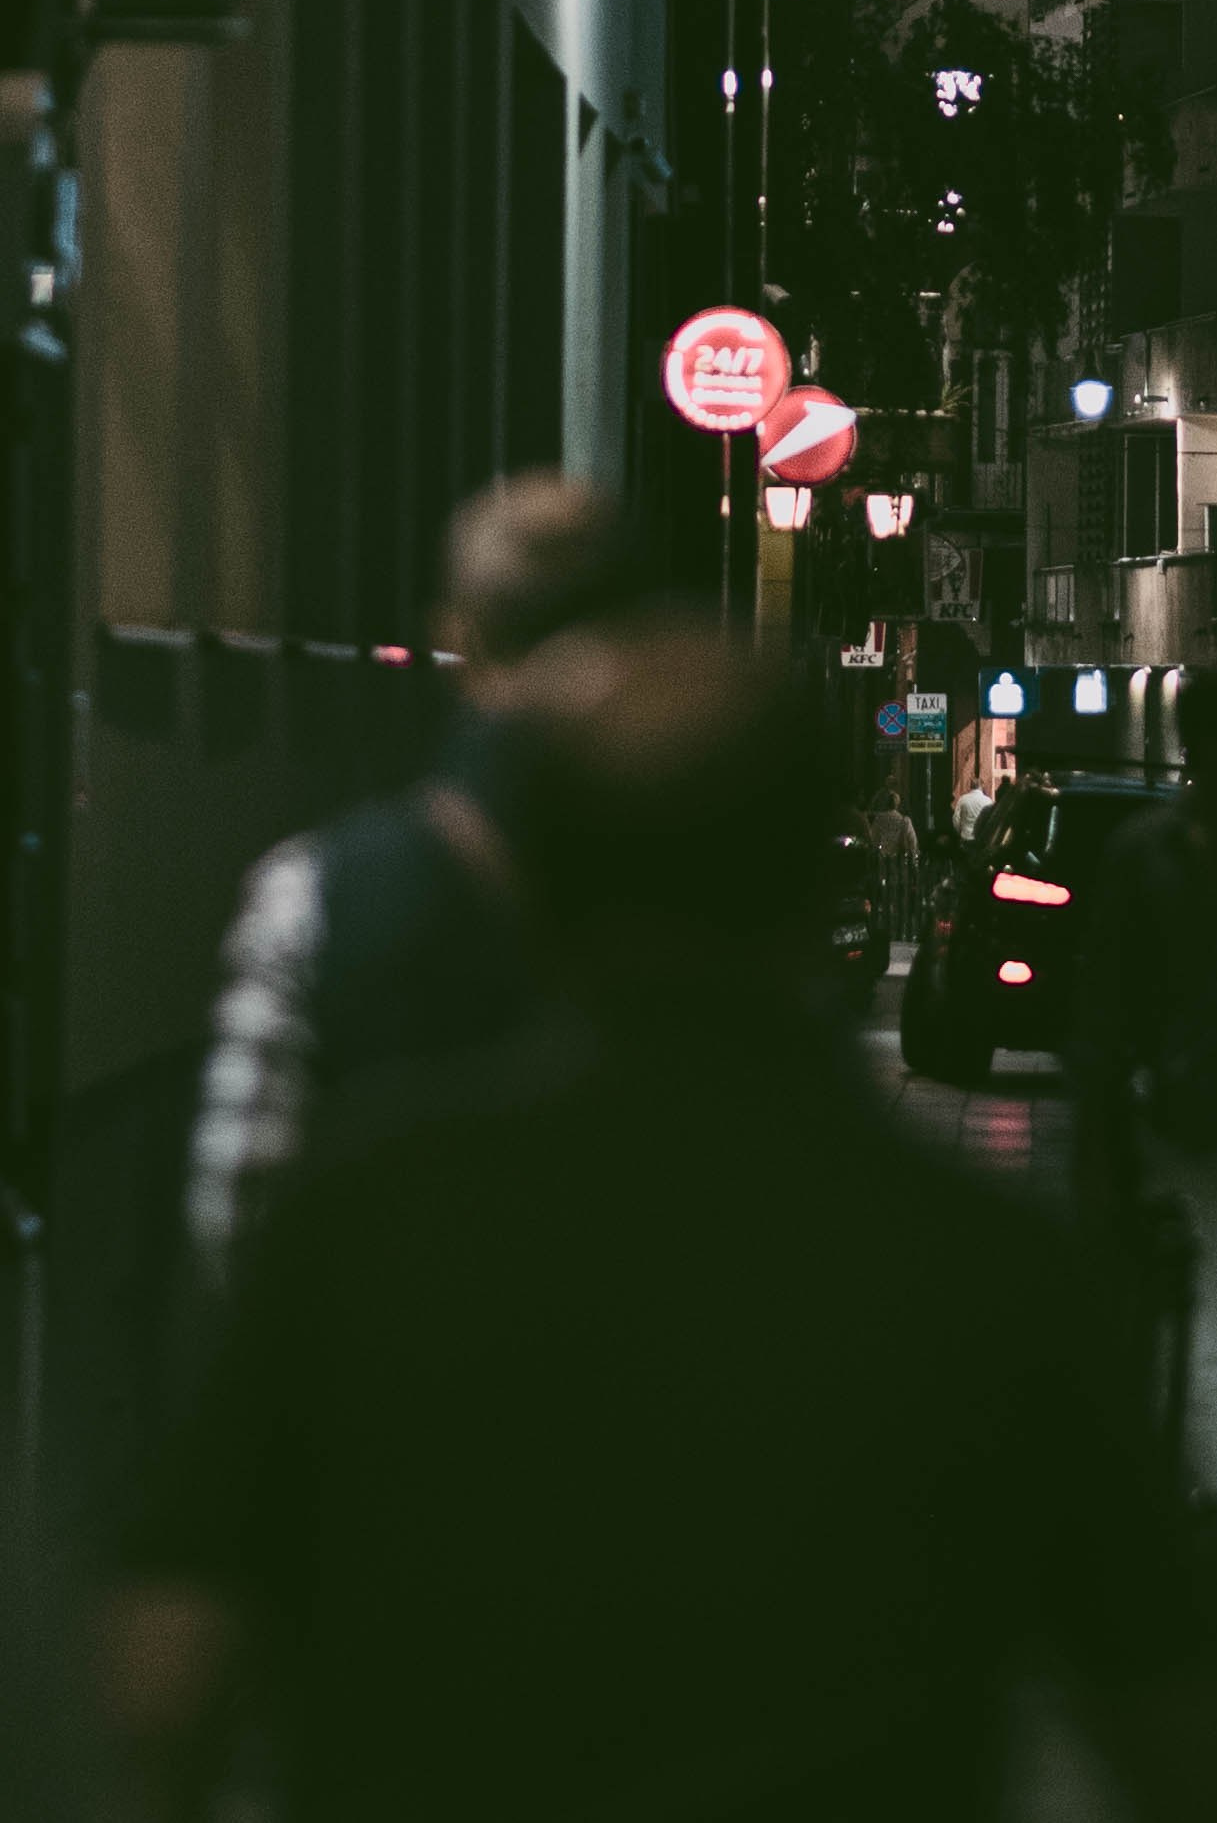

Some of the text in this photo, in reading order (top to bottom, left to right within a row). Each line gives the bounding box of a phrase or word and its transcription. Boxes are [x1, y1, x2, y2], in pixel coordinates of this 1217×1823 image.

[694, 344, 764, 375] 24/7
[938, 602, 974, 618] KFC
[848, 653, 877, 664] KFC
[914, 696, 940, 710] TAXI
